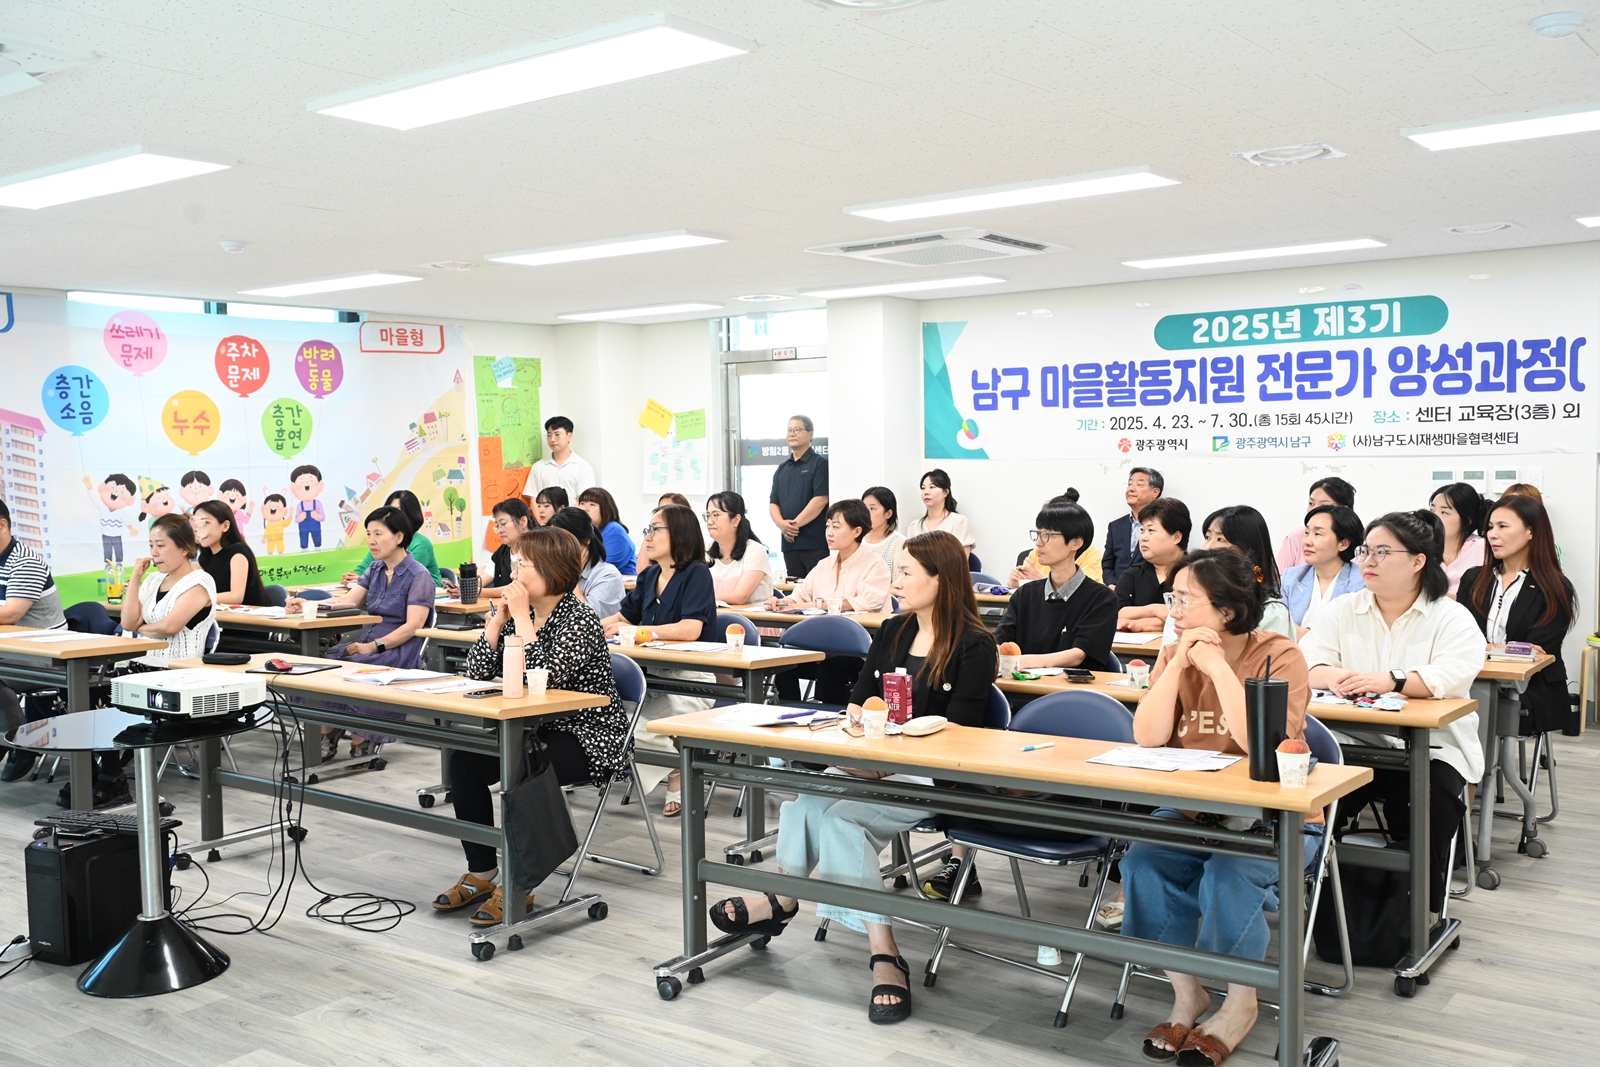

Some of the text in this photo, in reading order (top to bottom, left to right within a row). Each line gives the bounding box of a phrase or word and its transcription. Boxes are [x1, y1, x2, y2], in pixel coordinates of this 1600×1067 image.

[110, 323, 161, 340] 쓰레기
[1192, 301, 1401, 344] 2025년 제3기
[379, 327, 424, 347] 마을형
[120, 344, 153, 367] 문제
[226, 341, 259, 362] 주차
[302, 346, 336, 368] 반려
[55, 374, 93, 400] 층간
[226, 364, 260, 388] 문제
[308, 369, 333, 392] 동물
[971, 367, 1030, 411] 남구
[1040, 355, 1245, 409] 마을활동지원
[1256, 347, 1377, 402] 전문가
[60, 401, 94, 425] 소음
[172, 410, 211, 436] 누수
[272, 404, 303, 427] 층간
[1109, 415, 1148, 431] 2025.
[1153, 415, 1167, 430] 4.
[1171, 414, 1194, 430] 23.
[1211, 413, 1224, 428] 7.
[1275, 412, 1301, 426] 15회
[1305, 411, 1353, 426] 45시간)
[1415, 406, 1452, 423] 센터
[1458, 403, 1557, 422] 교육장(3층)
[1562, 402, 1581, 419] 외
[274, 427, 302, 450] 흡연
[1135, 438, 1188, 451] 광주광역시
[1351, 431, 1519, 448] (사)남구도시재생마을협력센터
[888, 703, 900, 711] ATER
[1177, 710, 1234, 739] C'ES
